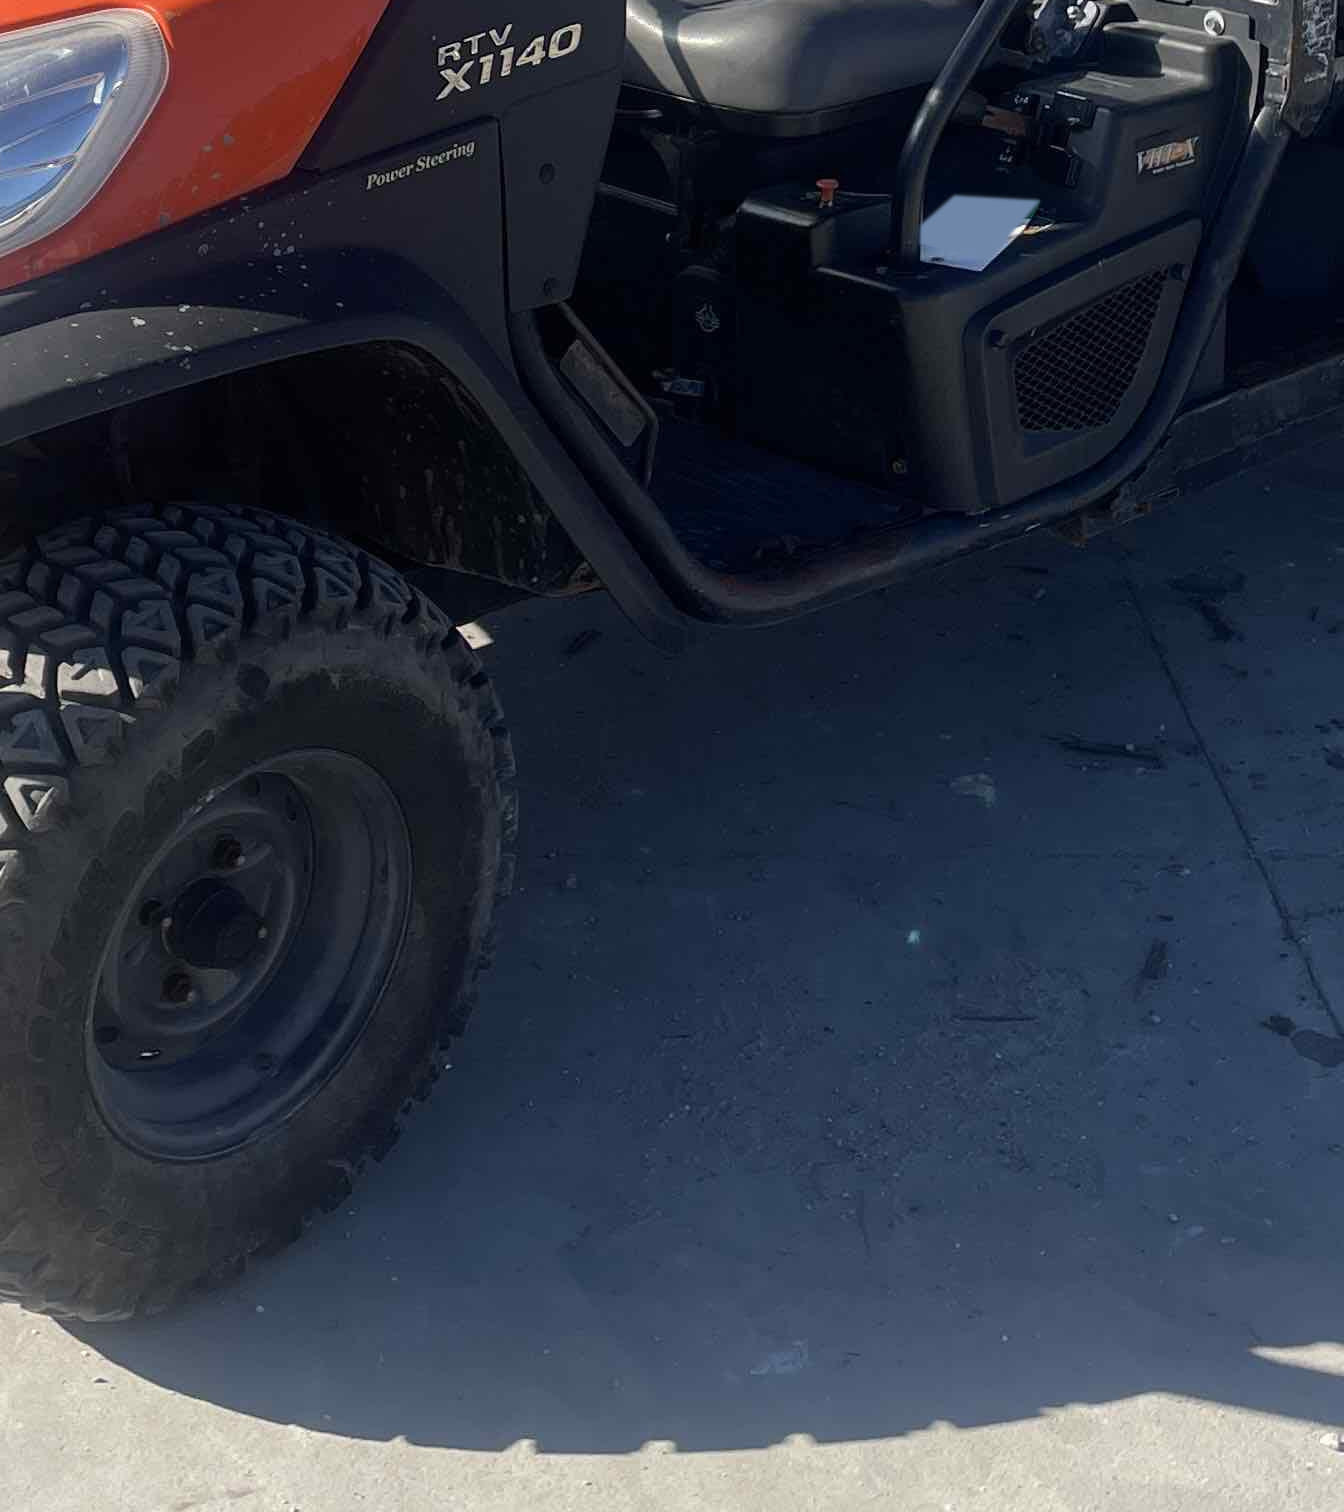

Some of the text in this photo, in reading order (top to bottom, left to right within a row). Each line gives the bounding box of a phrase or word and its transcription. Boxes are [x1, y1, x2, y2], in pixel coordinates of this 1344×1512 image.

[435, 23, 582, 101] X1140
[437, 23, 513, 66] RTV
[366, 141, 475, 190] Power Steering
